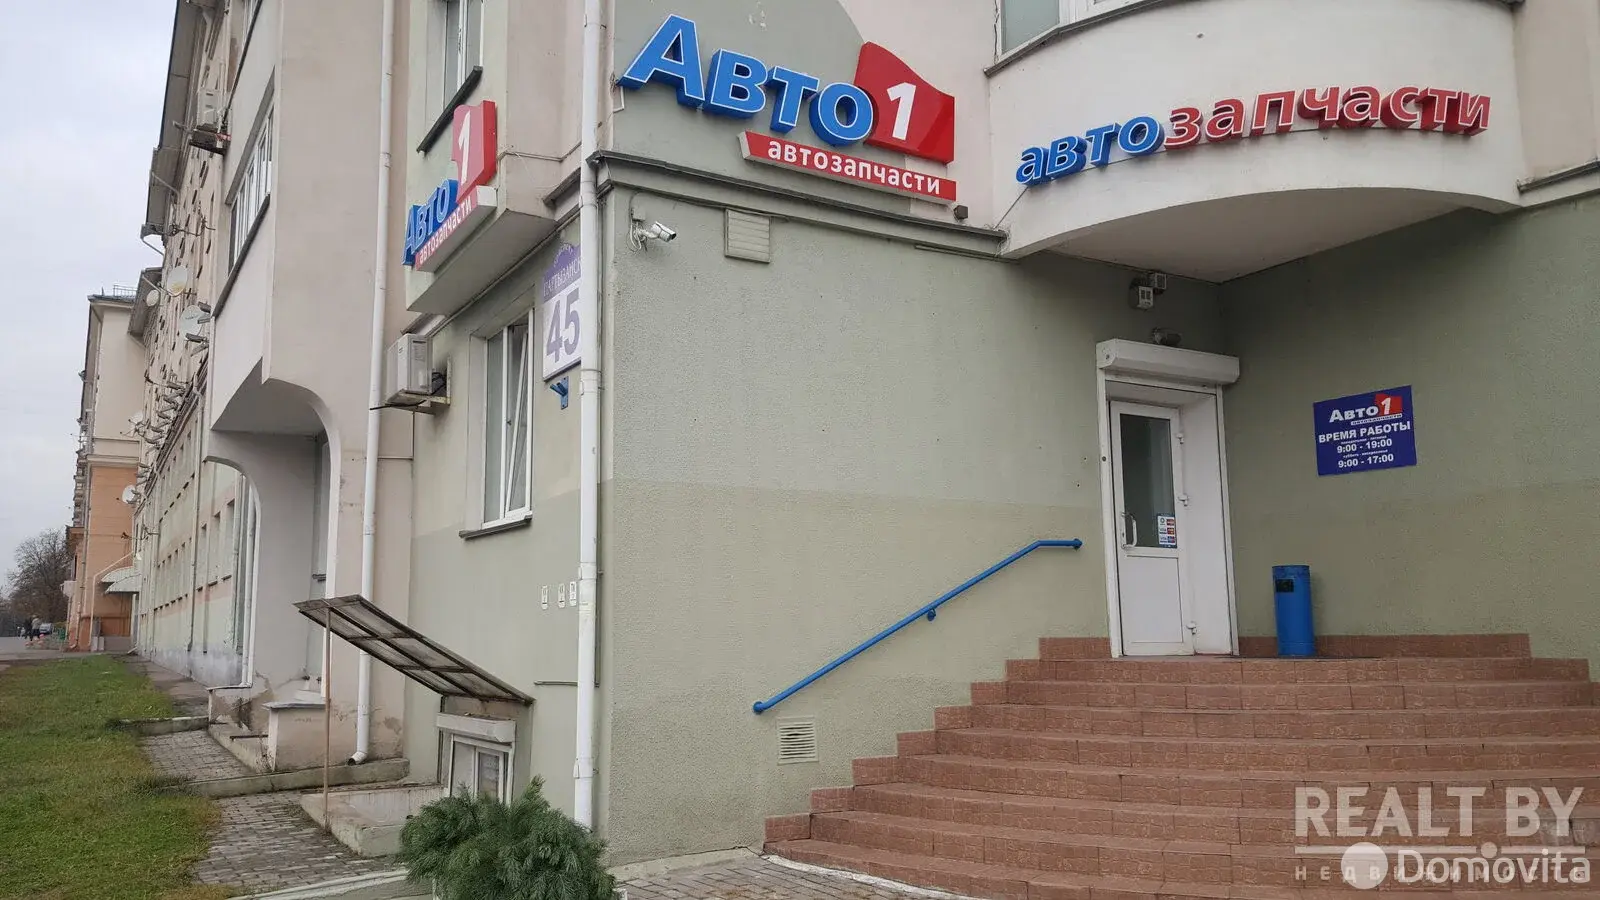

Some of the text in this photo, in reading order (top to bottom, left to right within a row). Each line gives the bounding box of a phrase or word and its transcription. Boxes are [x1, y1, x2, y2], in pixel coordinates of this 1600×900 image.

[1016, 84, 1491, 187] автозапчасти
[768, 140, 940, 195] автозапчасти
[419, 195, 473, 265] автозапчасти
[546, 287, 580, 363] 45
[1319, 421, 1411, 443] ВРЕМЯ РАБОТЫ
[1337, 444, 1357, 453] 9:00
[1366, 438, 1393, 449] 19:00
[1338, 459, 1358, 468] 9:00
[1367, 453, 1394, 464] 17:00
